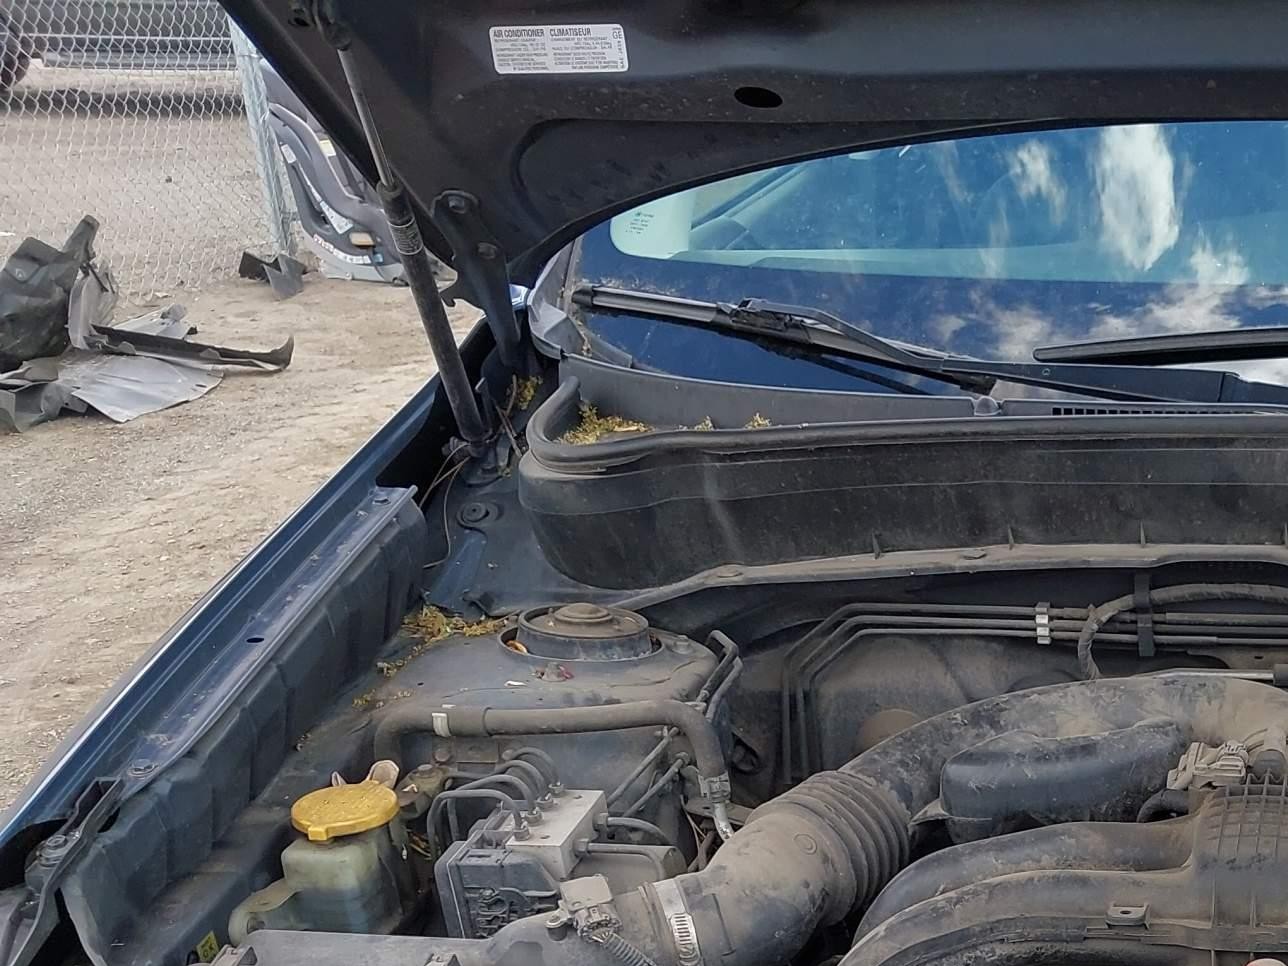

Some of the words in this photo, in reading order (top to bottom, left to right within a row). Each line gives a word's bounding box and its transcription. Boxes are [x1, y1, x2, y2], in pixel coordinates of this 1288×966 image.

[493, 29, 504, 38] AIR
[504, 28, 545, 38] CONDITIONER
[549, 28, 592, 37] CLIMATISEUR
[612, 31, 623, 40] GE
